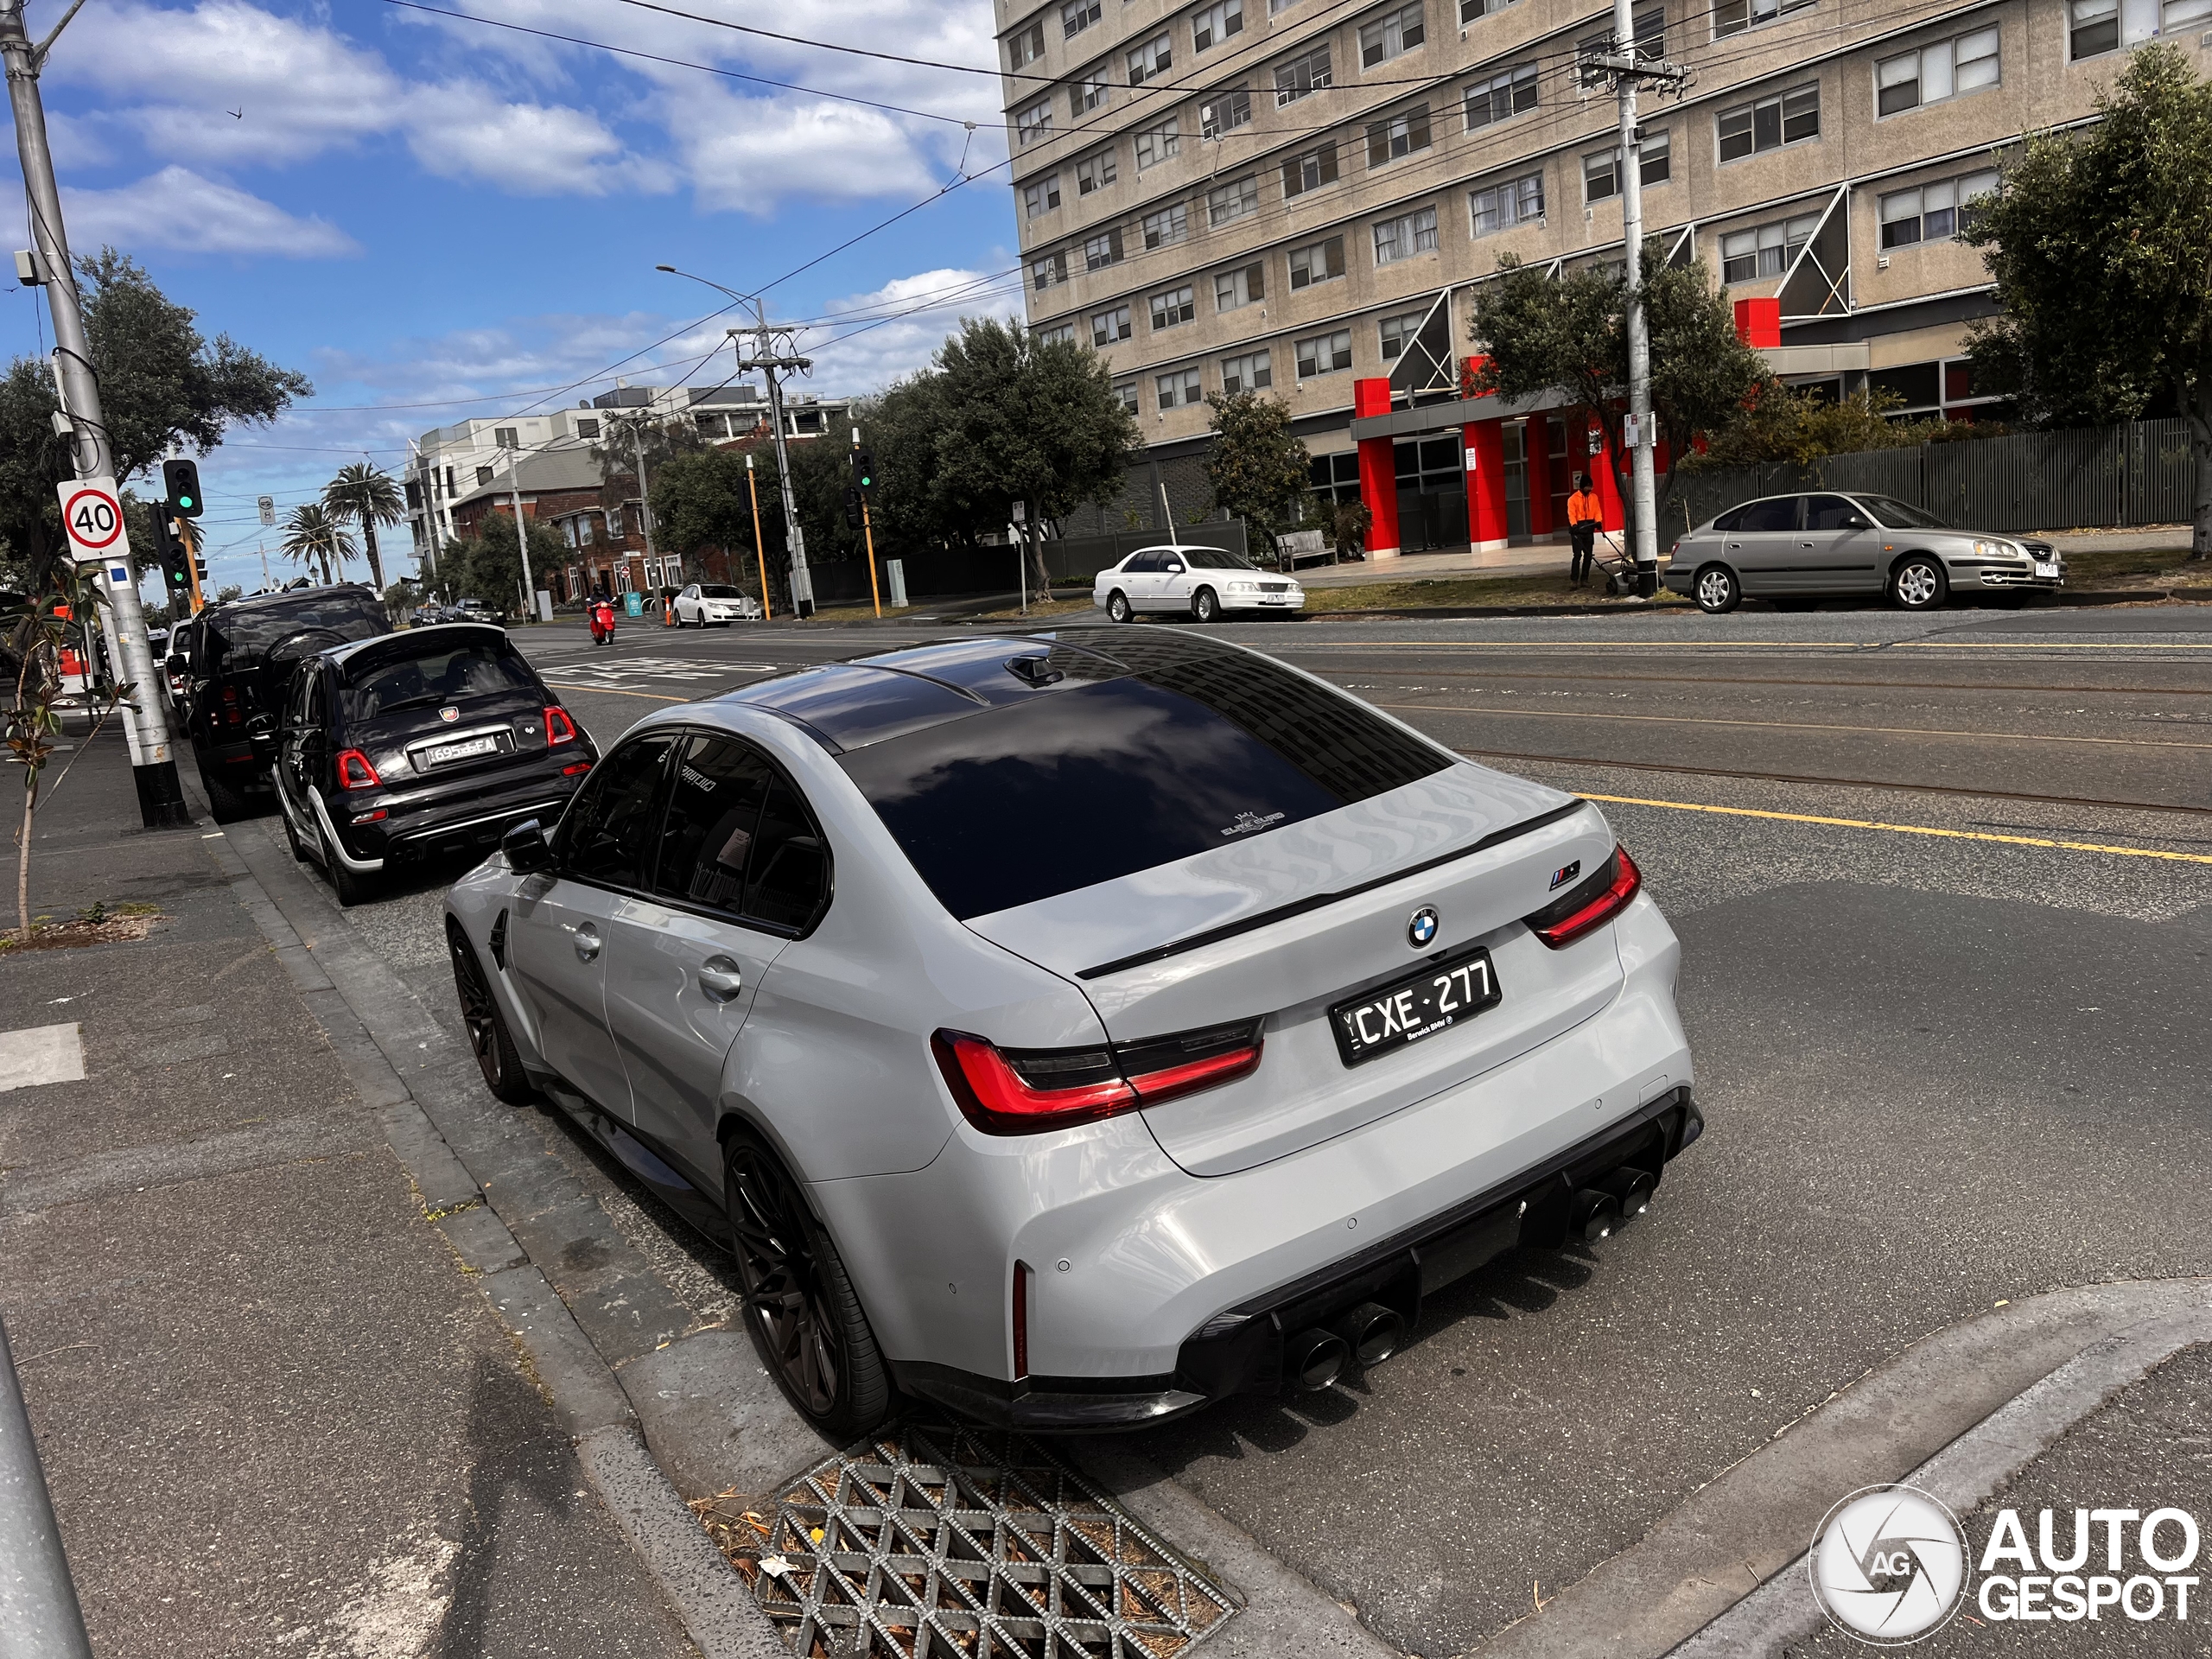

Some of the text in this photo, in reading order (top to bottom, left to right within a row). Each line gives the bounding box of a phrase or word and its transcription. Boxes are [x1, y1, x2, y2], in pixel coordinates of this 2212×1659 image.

[75, 504, 114, 533] 40
[541, 659, 684, 678] RAM
[1411, 909, 1437, 926] BMW
[1355, 959, 1490, 1045] CXE 277
[1407, 1019, 1446, 1041] Berwick BMW
